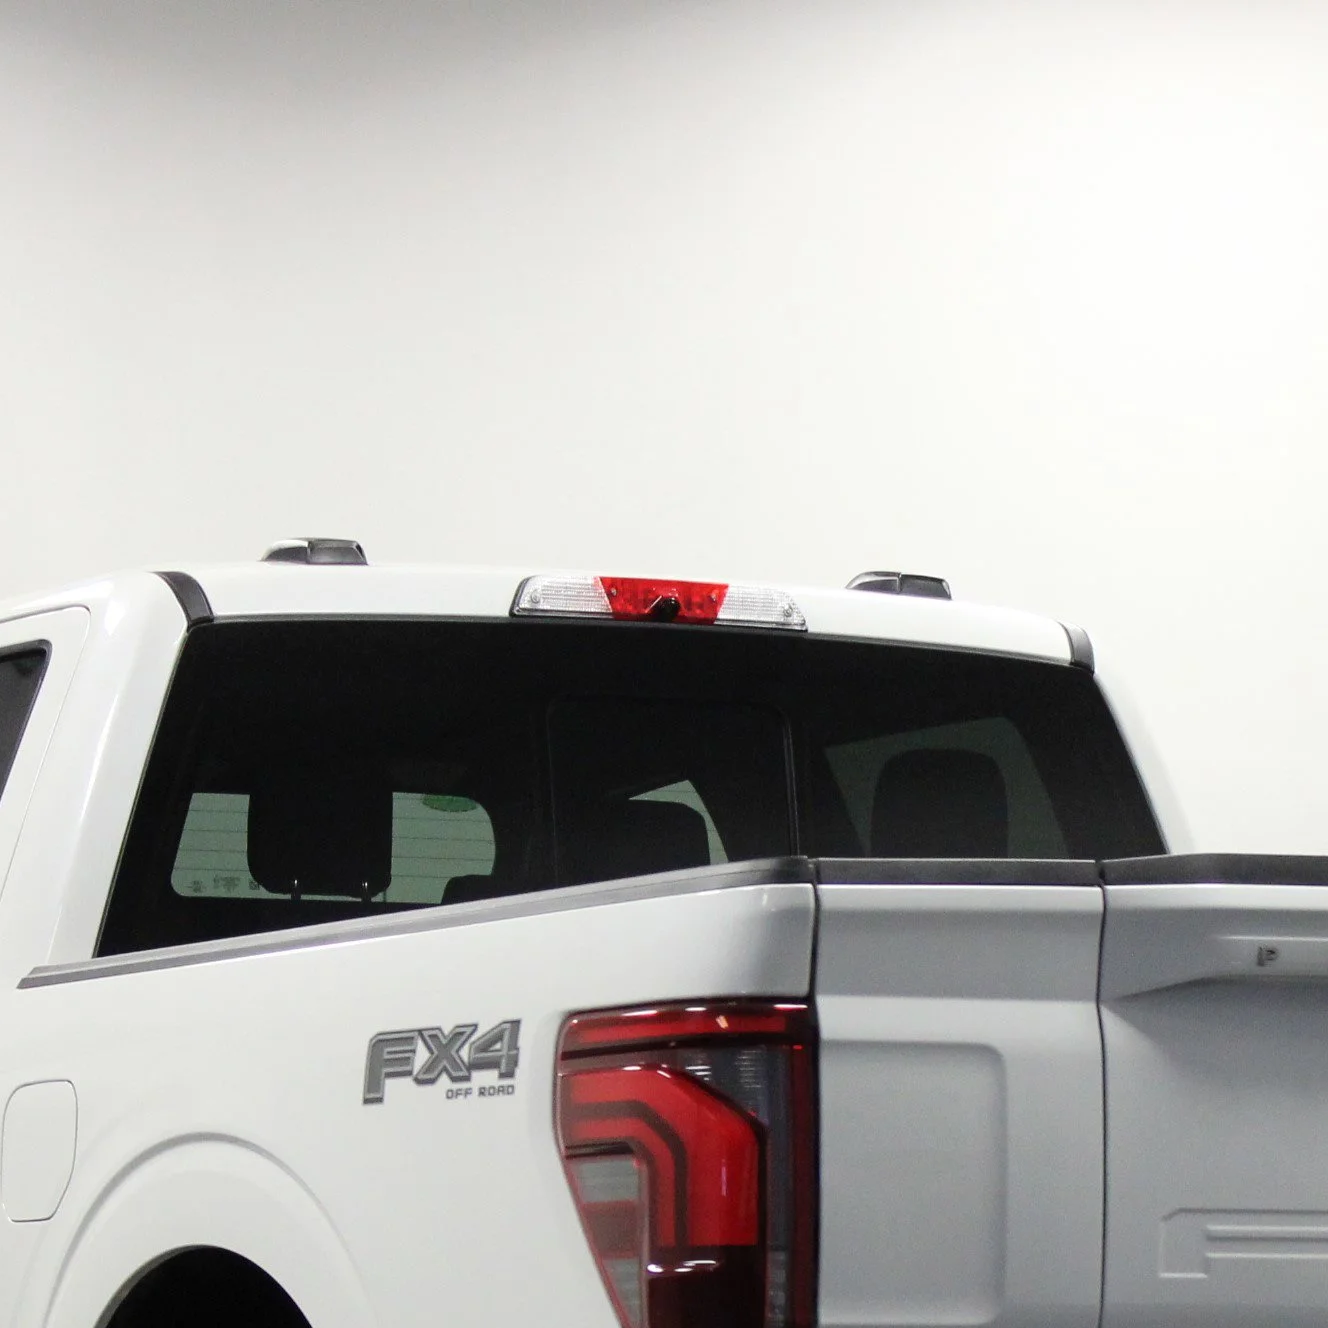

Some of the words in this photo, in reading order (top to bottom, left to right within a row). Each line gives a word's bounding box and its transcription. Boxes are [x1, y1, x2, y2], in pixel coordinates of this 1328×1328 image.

[363, 1019, 521, 1105] FX4
[446, 1088, 472, 1099] OFF
[478, 1084, 515, 1097] ROAD
